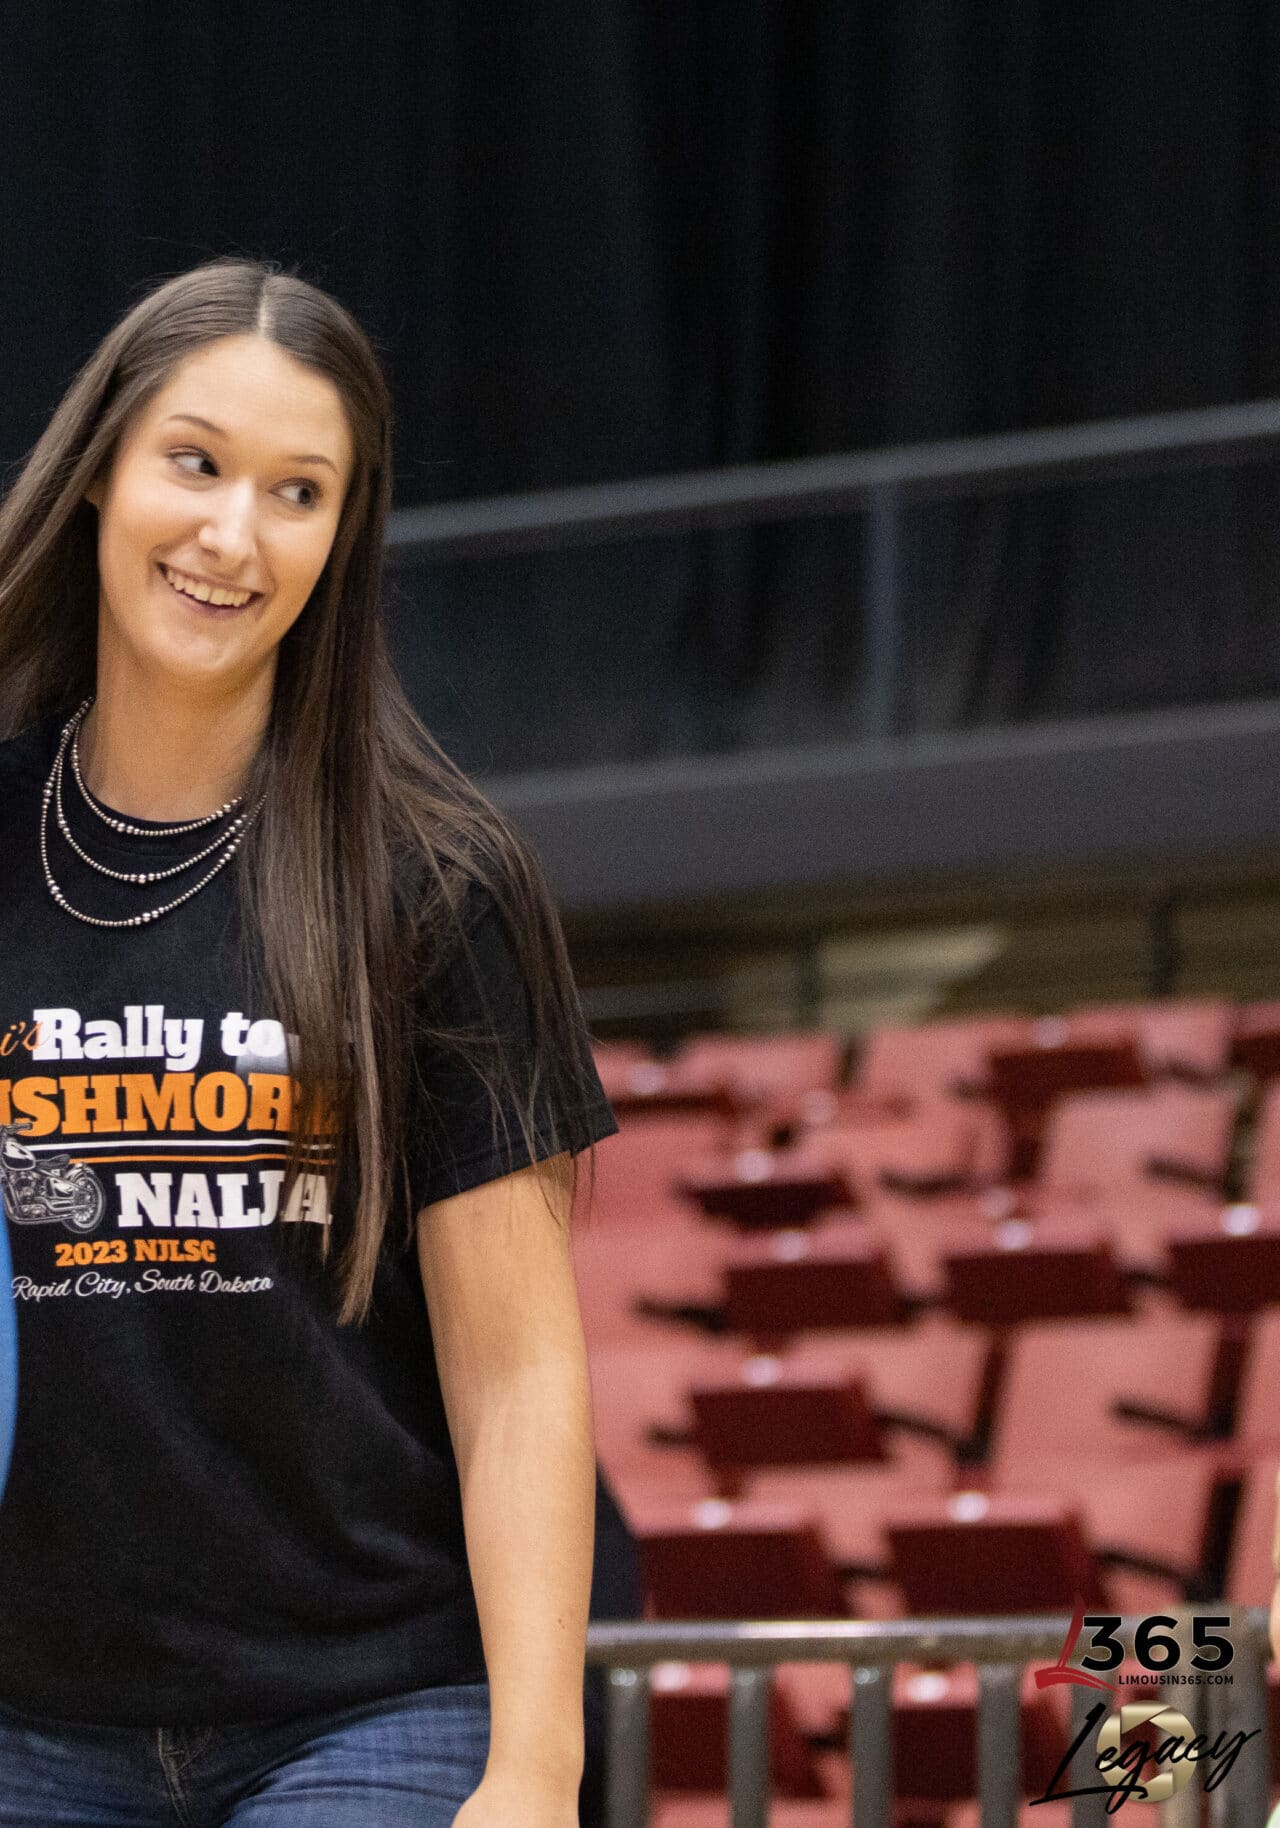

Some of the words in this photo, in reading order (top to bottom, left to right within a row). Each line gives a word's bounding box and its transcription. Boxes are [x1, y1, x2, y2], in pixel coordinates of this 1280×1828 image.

[32, 1004, 204, 1072] Rally
[220, 1011, 287, 1058] to
[115, 1170, 333, 1229] NALJA
[54, 1239, 128, 1267] 2023
[134, 1238, 217, 1263] NJLSC
[11, 1276, 71, 1302] Rapid
[75, 1271, 131, 1299] City,
[134, 1268, 196, 1294] South
[199, 1269, 274, 1294] Dakota
